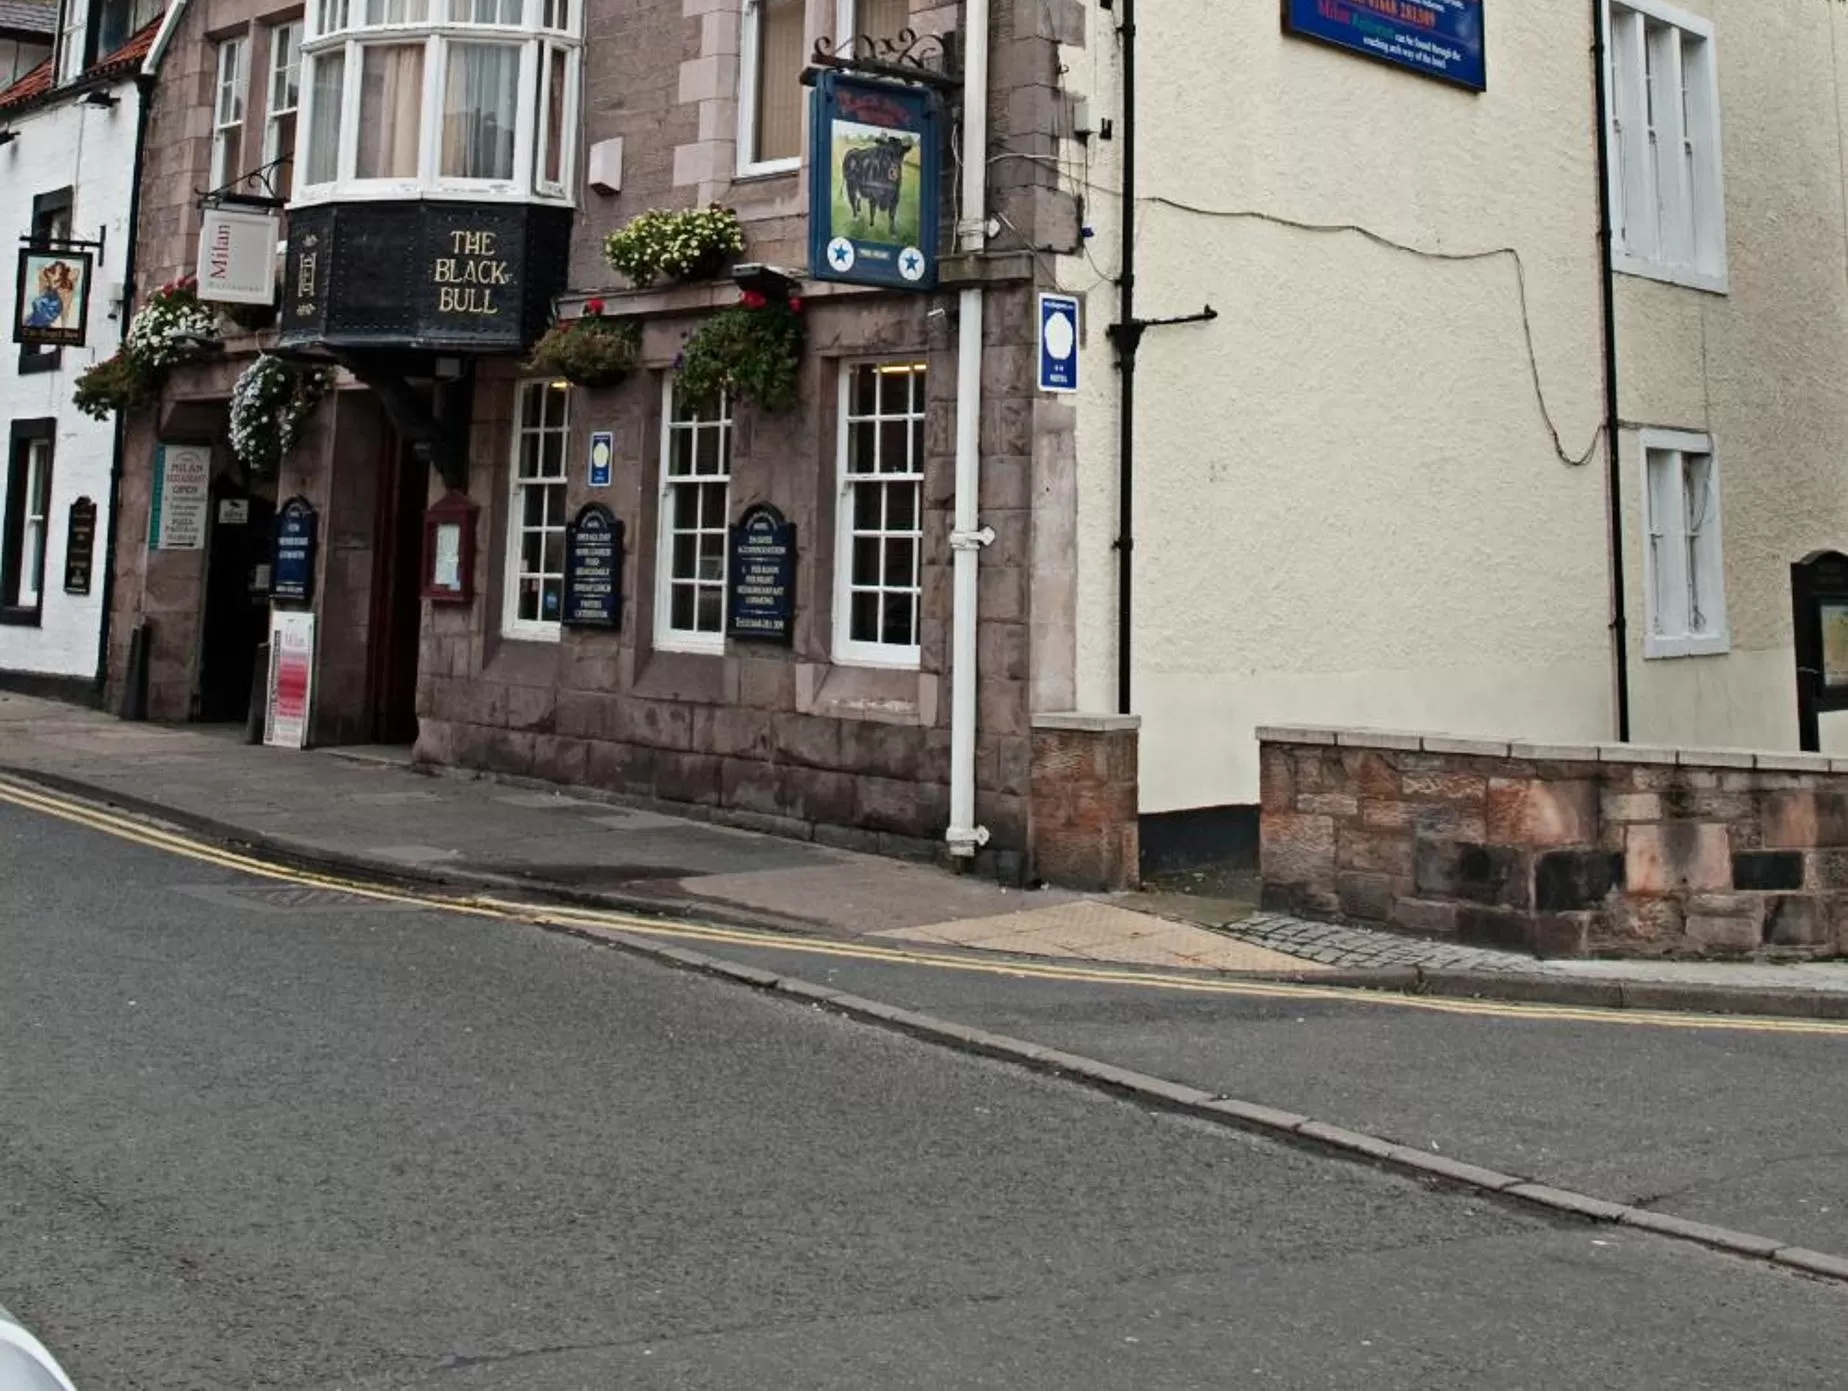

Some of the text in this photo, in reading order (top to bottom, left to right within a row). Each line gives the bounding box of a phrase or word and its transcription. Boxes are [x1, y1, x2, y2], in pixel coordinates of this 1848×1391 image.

[209, 224, 231, 280] Milan
[450, 230, 496, 255] THE
[434, 258, 508, 285] BLACK
[438, 287, 499, 314] BULL
[171, 463, 203, 474] MILAN
